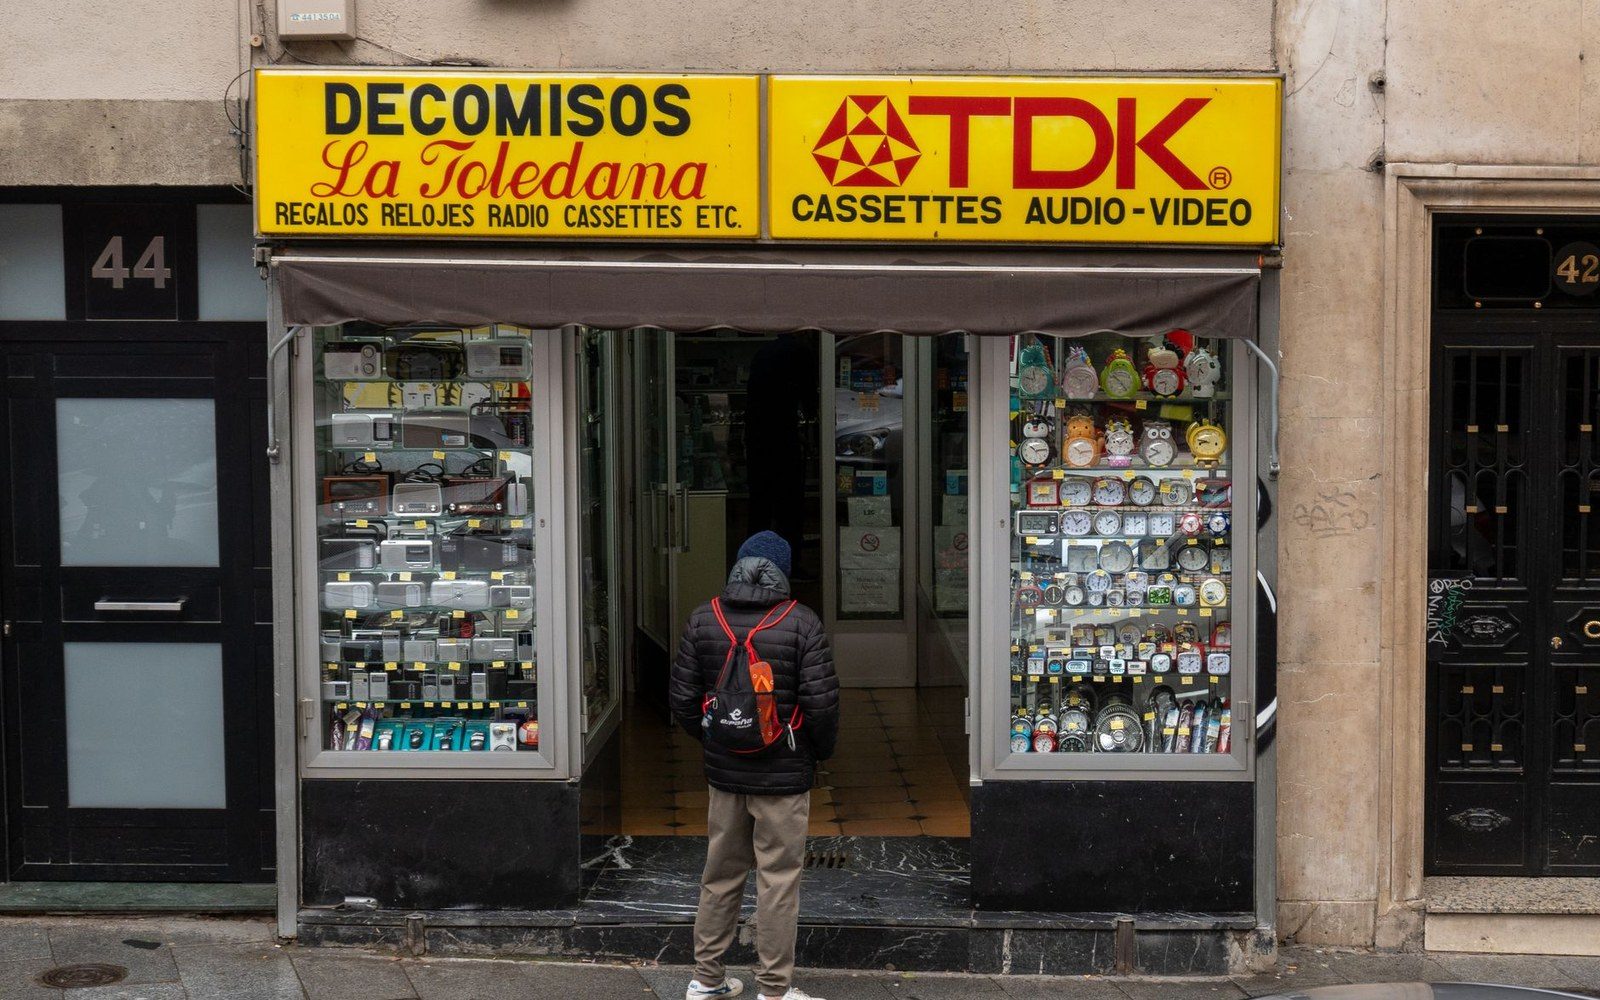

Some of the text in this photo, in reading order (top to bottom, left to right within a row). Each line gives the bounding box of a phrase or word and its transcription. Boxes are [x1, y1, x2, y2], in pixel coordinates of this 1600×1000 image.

[325, 82, 691, 137] DECOMISOS
[908, 95, 1213, 190] TDK
[311, 140, 708, 200] La Toledana
[275, 202, 742, 229] REGALOS RELOJES RADIO CASSETTES ETC.
[792, 194, 1002, 225] CASSETTES
[91, 235, 172, 289] 44
[1556, 254, 1600, 284] 42
